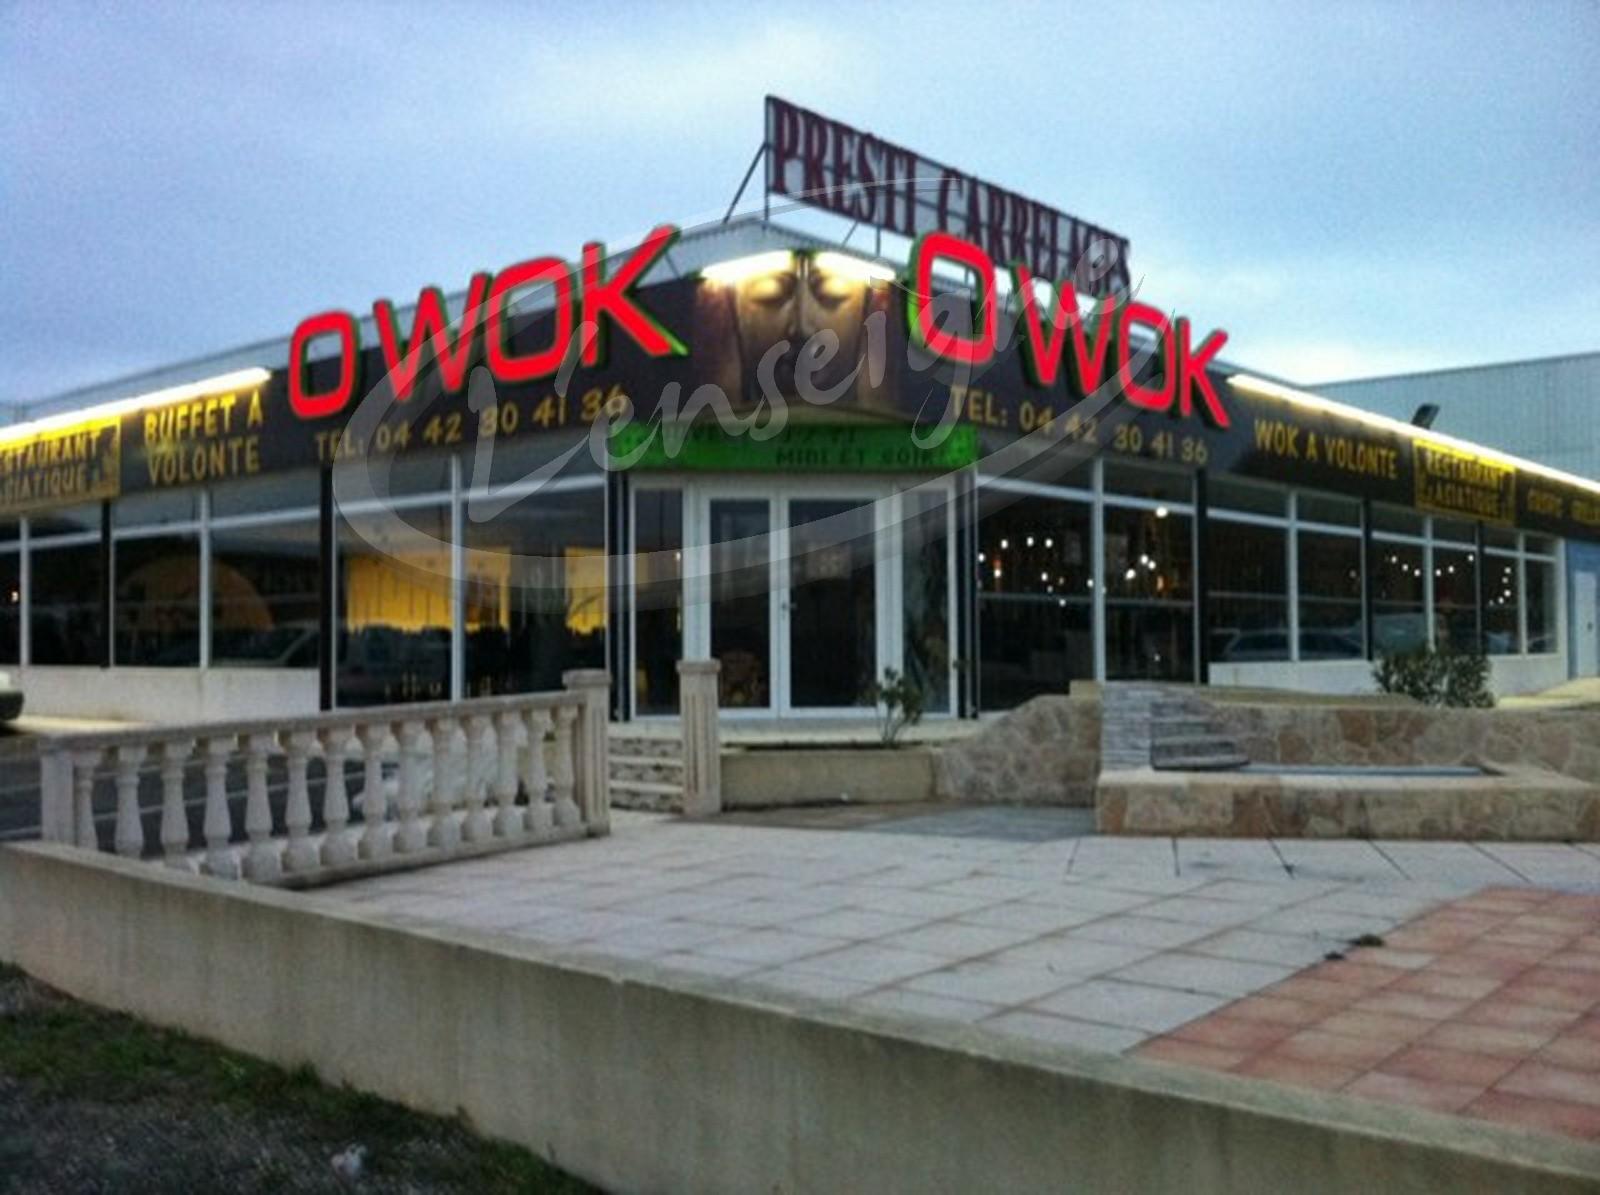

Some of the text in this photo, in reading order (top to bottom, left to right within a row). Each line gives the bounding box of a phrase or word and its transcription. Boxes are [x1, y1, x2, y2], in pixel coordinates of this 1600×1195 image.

[144, 387, 265, 447] BUFFET A
[315, 382, 627, 462] TEL: 04 42 30 41 36
[950, 384, 1209, 464] TEL: 04 42 30 41 36
[147, 435, 261, 487] VOLONTE
[1254, 418, 1399, 481] WOK A VOLONTE
